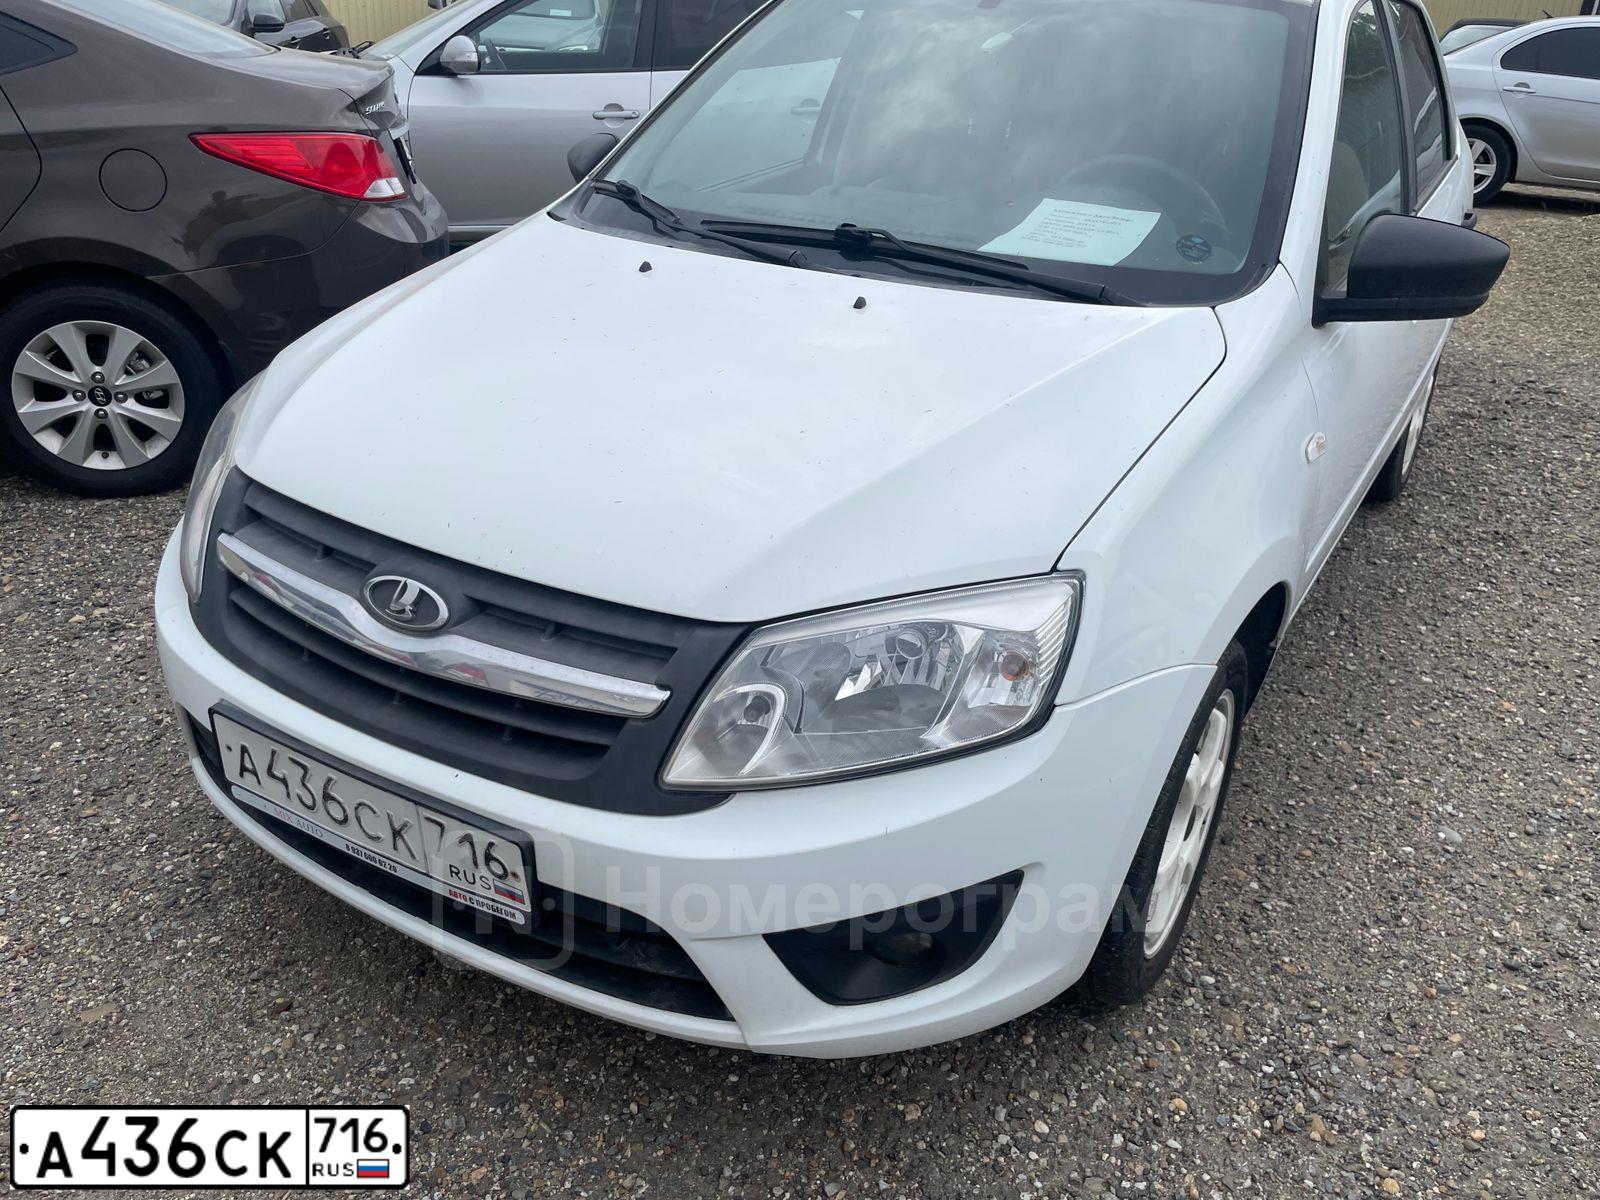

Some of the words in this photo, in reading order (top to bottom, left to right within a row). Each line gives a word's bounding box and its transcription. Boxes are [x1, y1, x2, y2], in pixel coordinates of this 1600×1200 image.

[238, 741, 420, 862] А436СК
[423, 812, 510, 881] 716
[273, 807, 293, 824] MIX
[296, 818, 324, 838] AUTO
[448, 863, 492, 891] RUS
[448, 889, 468, 903] АВТО
[475, 899, 517, 921] ПРОБЕГОМ
